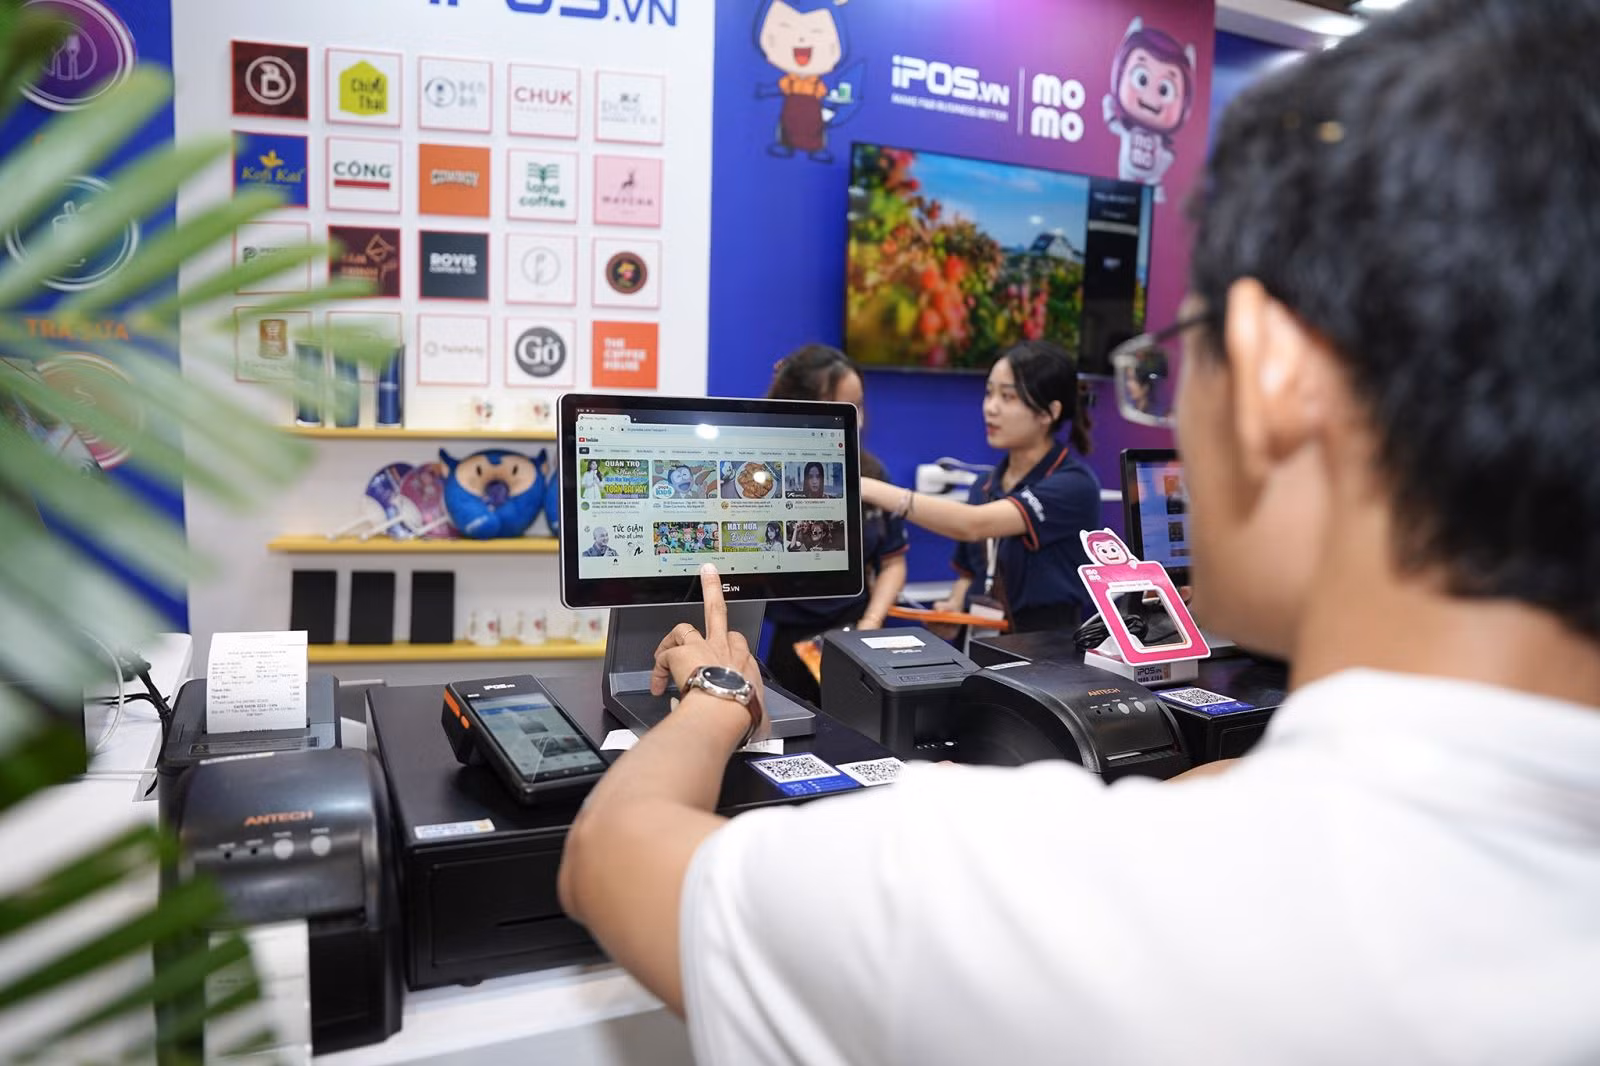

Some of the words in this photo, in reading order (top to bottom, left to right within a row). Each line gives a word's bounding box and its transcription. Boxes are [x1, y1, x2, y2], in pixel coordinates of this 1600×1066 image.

[891, 54, 1010, 106] iPOS.VN
[514, 86, 573, 106] CHUK
[722, 583, 740, 592] S.VN
[1088, 688, 1120, 697] ANTECH
[244, 810, 314, 827] ANTECH
